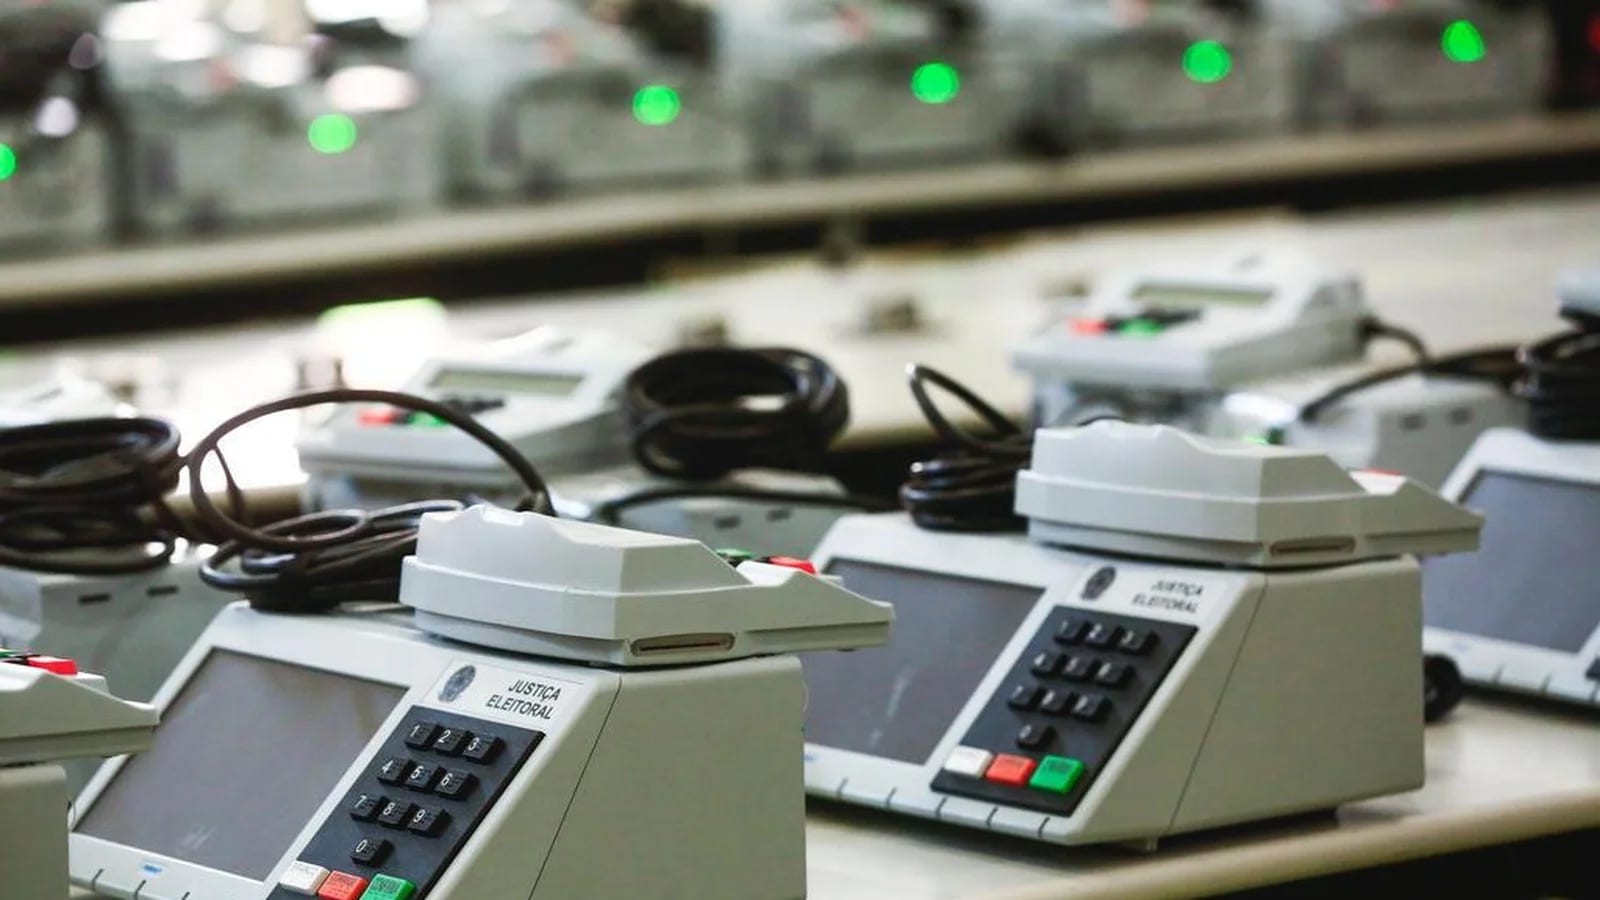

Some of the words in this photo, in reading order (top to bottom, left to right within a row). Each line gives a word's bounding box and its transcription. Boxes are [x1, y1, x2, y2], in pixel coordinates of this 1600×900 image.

[508, 679, 562, 702] JUSTIÇA
[486, 694, 554, 720] ELEITORAL
[410, 724, 421, 738] 1
[438, 729, 452, 744] 2
[468, 737, 480, 751] 3
[381, 760, 394, 774] 4
[440, 773, 453, 787] 6
[354, 794, 368, 809] 7
[382, 802, 396, 816] 8
[412, 809, 426, 823] 9
[355, 839, 368, 853] 0
